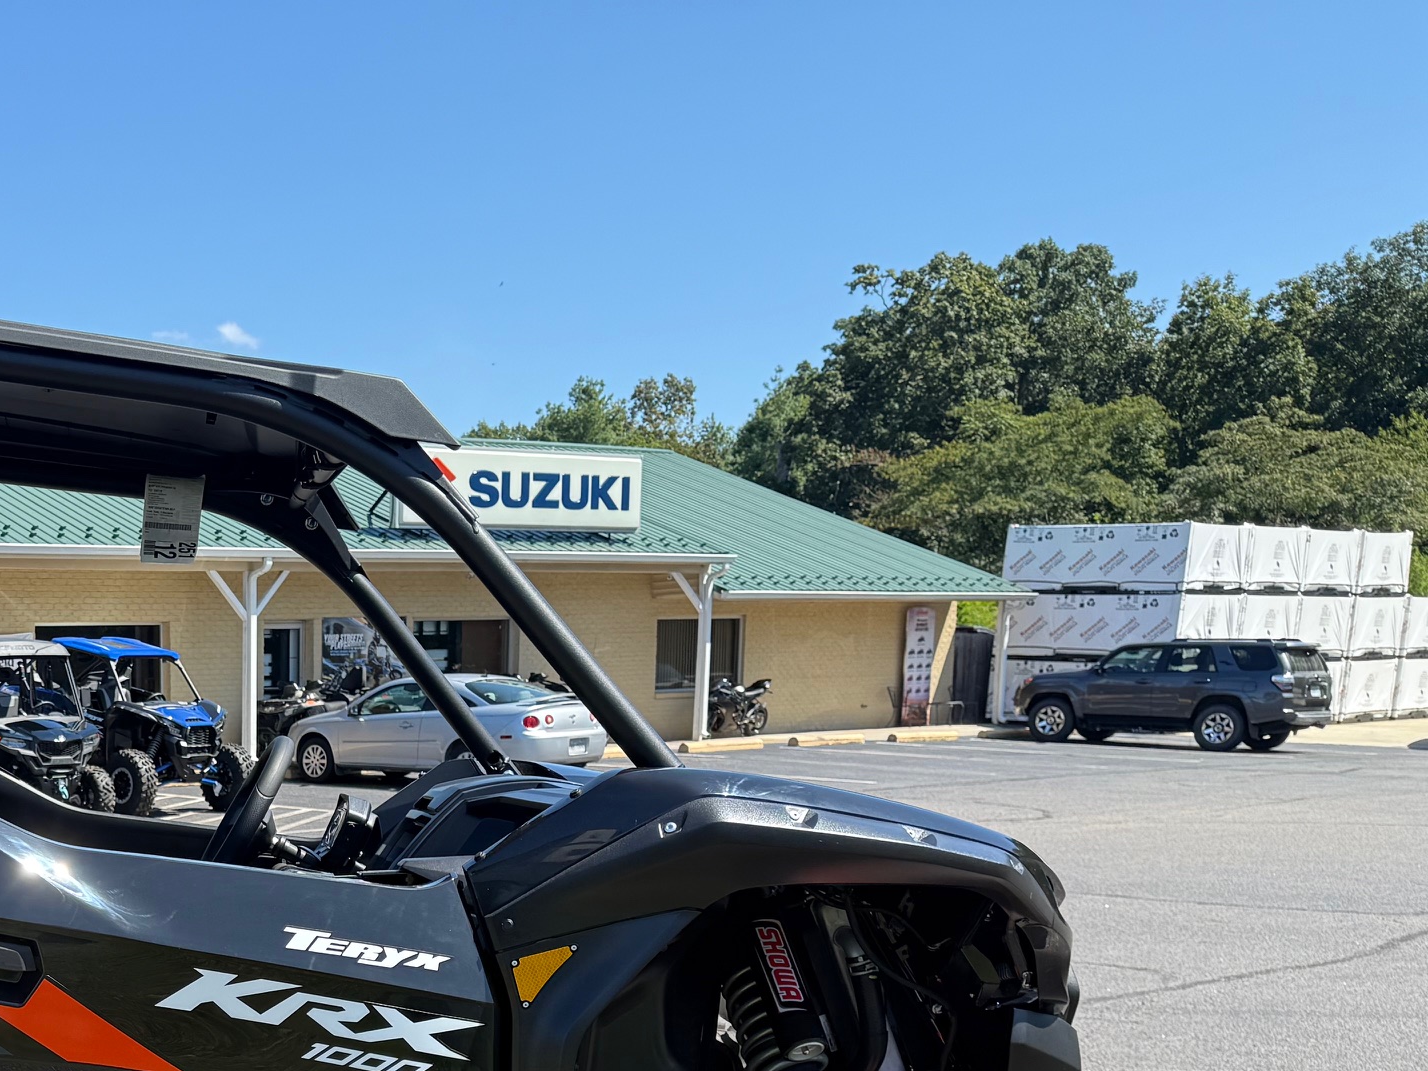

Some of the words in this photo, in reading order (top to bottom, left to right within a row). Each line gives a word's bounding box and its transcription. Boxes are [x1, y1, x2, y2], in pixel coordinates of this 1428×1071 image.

[468, 469, 631, 511] SUZUKI
[154, 543, 177, 559] 12
[755, 926, 804, 1002] SHOWA
[154, 967, 486, 1062] KRX
